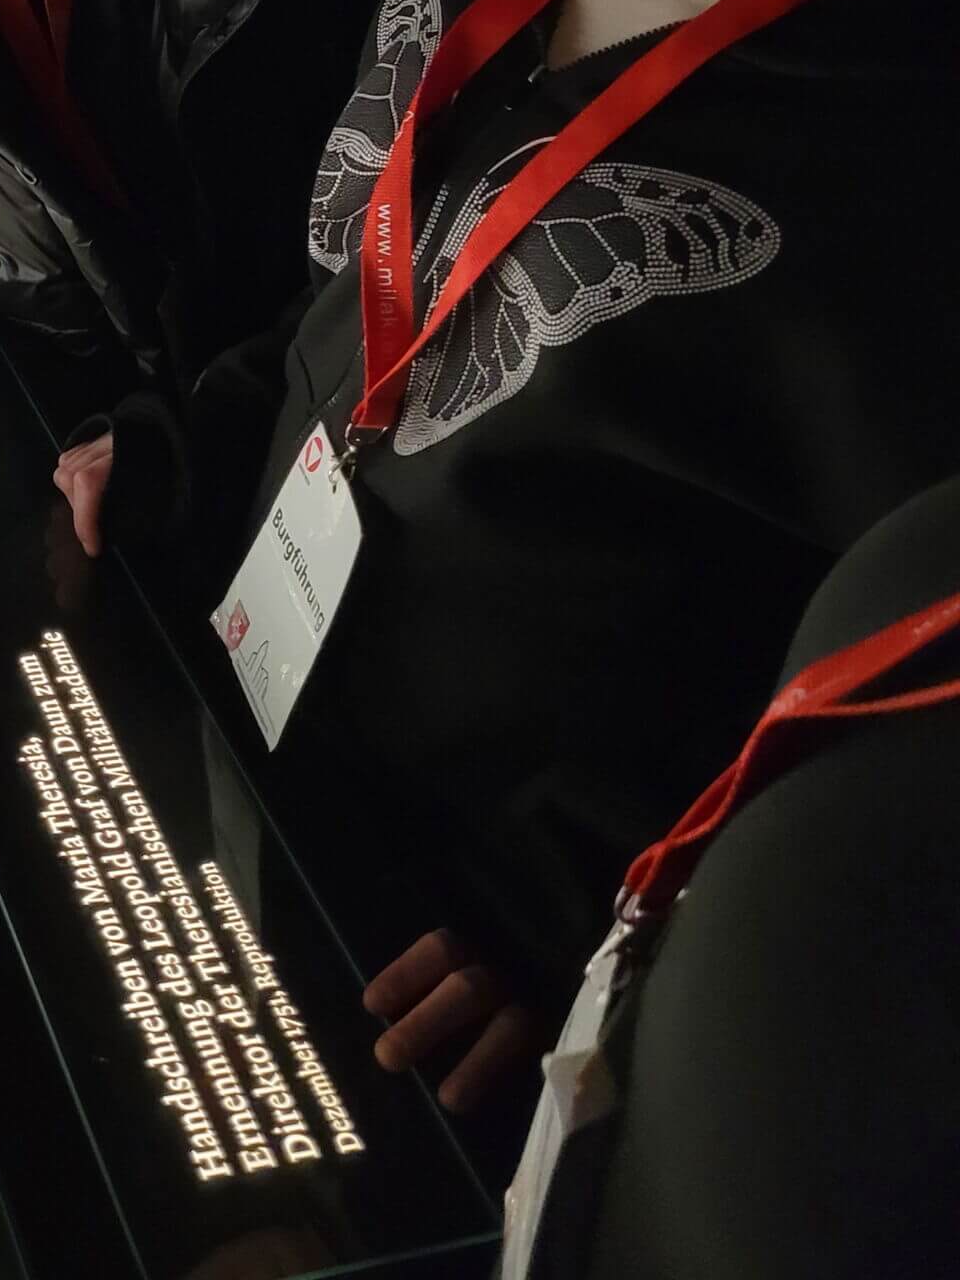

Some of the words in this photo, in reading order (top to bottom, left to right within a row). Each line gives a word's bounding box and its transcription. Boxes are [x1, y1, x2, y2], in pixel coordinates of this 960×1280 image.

[271, 507, 326, 633] Burgführung
[19, 653, 55, 697] zum
[41, 630, 137, 789] Militärakademie
[40, 697, 81, 755] Daun
[66, 755, 100, 797] von
[18, 735, 78, 835] Theresia,
[74, 797, 124, 849] Graf
[58, 834, 111, 906] Maria
[100, 850, 174, 951] Leopold
[121, 789, 230, 982] Theresianischen
[93, 906, 132, 957] von
[155, 951, 194, 997] des
[199, 860, 281, 990] Reproduktion
[213, 983, 255, 1029] der
[268, 990, 306, 1038] 1751,
[116, 957, 234, 1181] Handschreiben
[177, 998, 279, 1173] Ernennung
[237, 1033, 322, 1164] Direktor
[290, 1039, 366, 1155] Dezember
